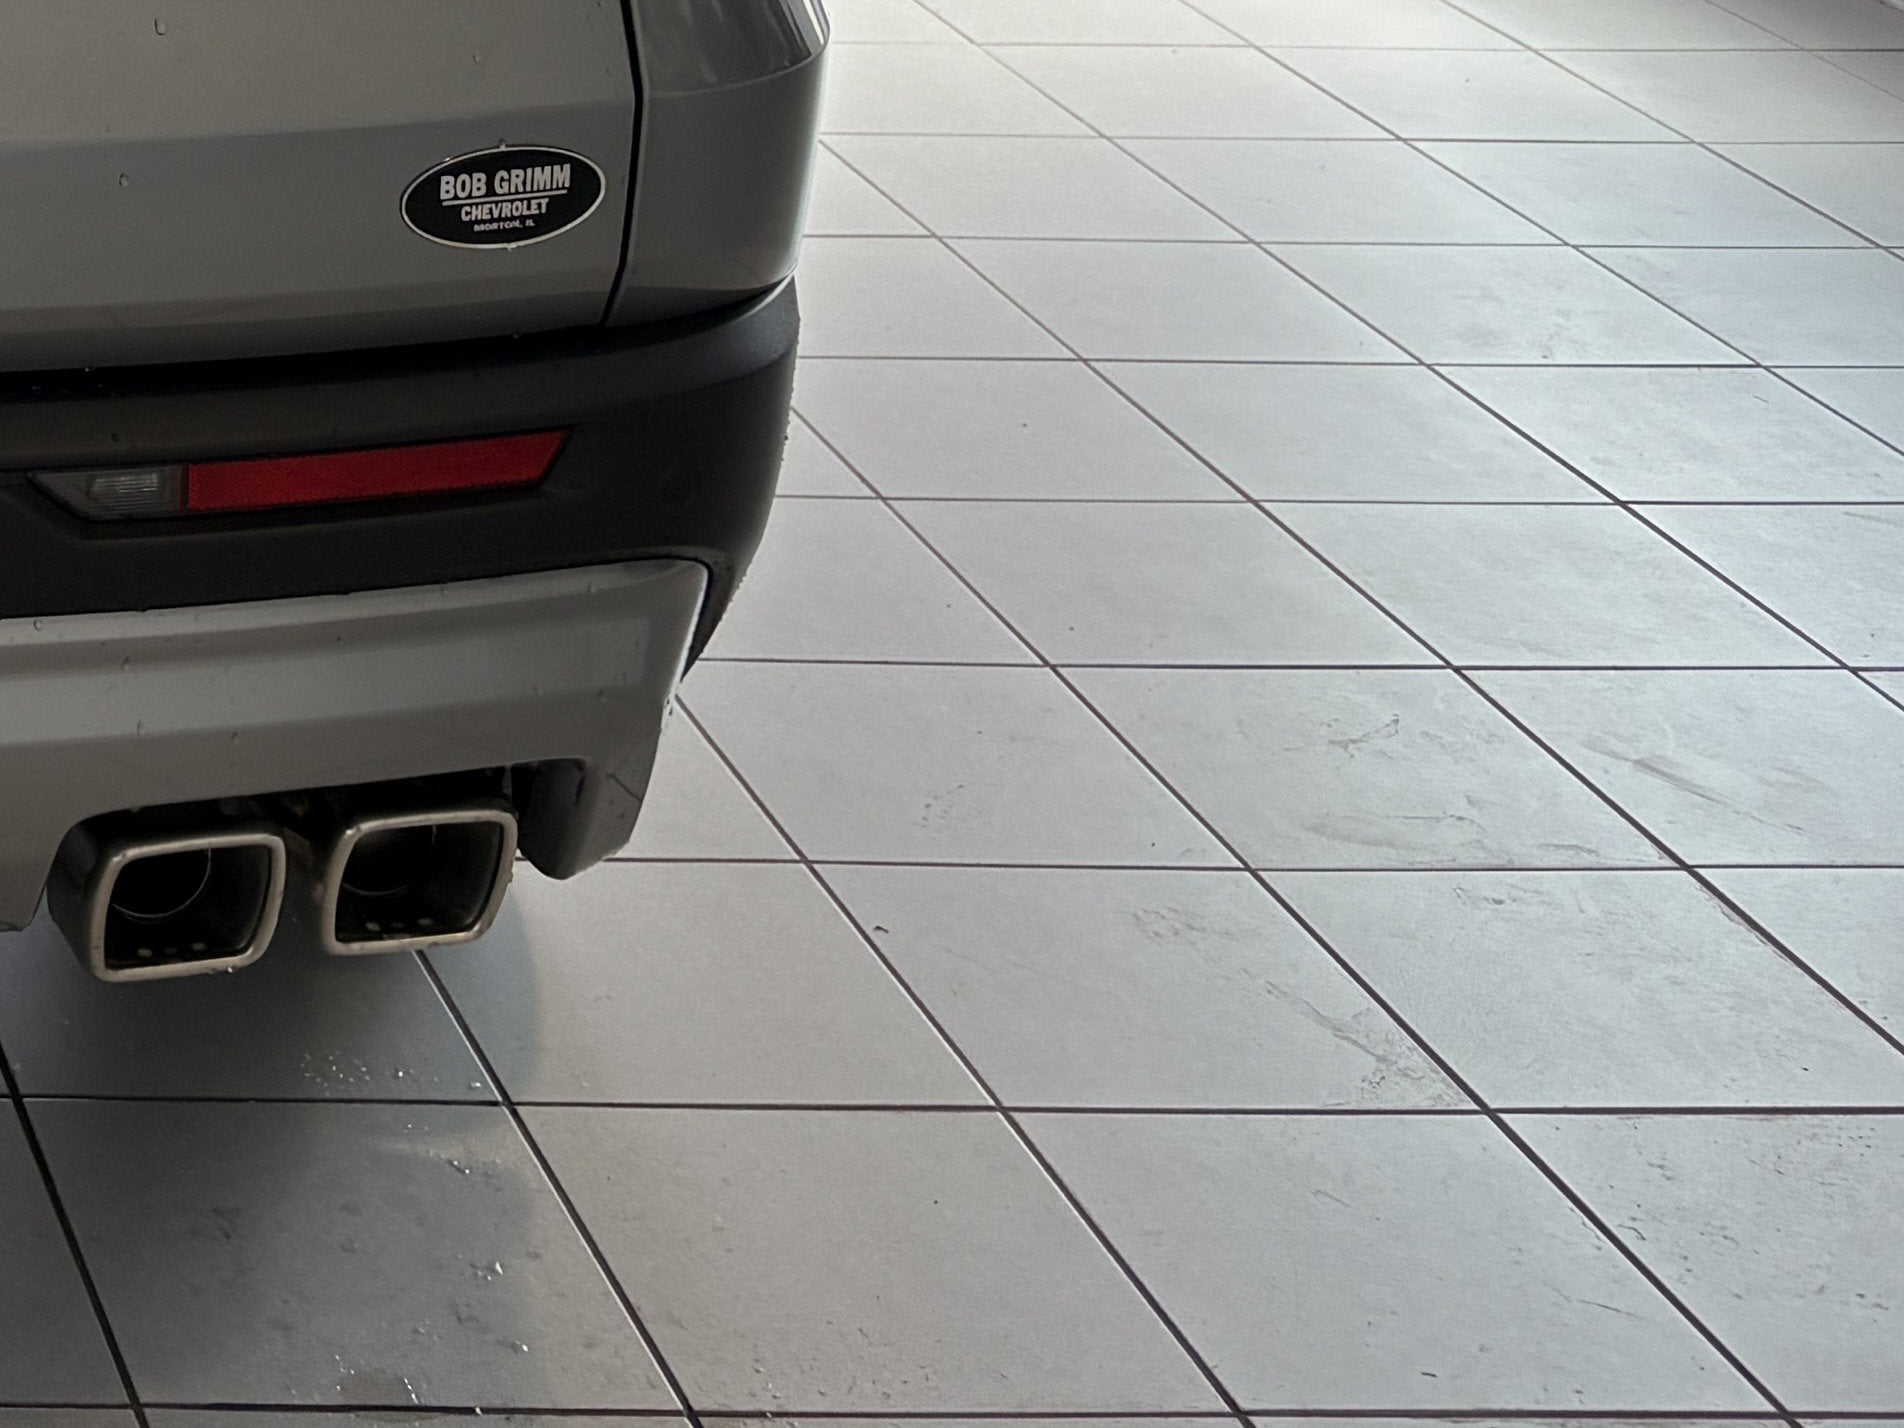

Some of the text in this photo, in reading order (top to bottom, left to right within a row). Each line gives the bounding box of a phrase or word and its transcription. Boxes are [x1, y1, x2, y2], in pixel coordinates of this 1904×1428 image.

[440, 163, 571, 200] BOB GRIMM
[461, 198, 549, 221] CHEVROLET
